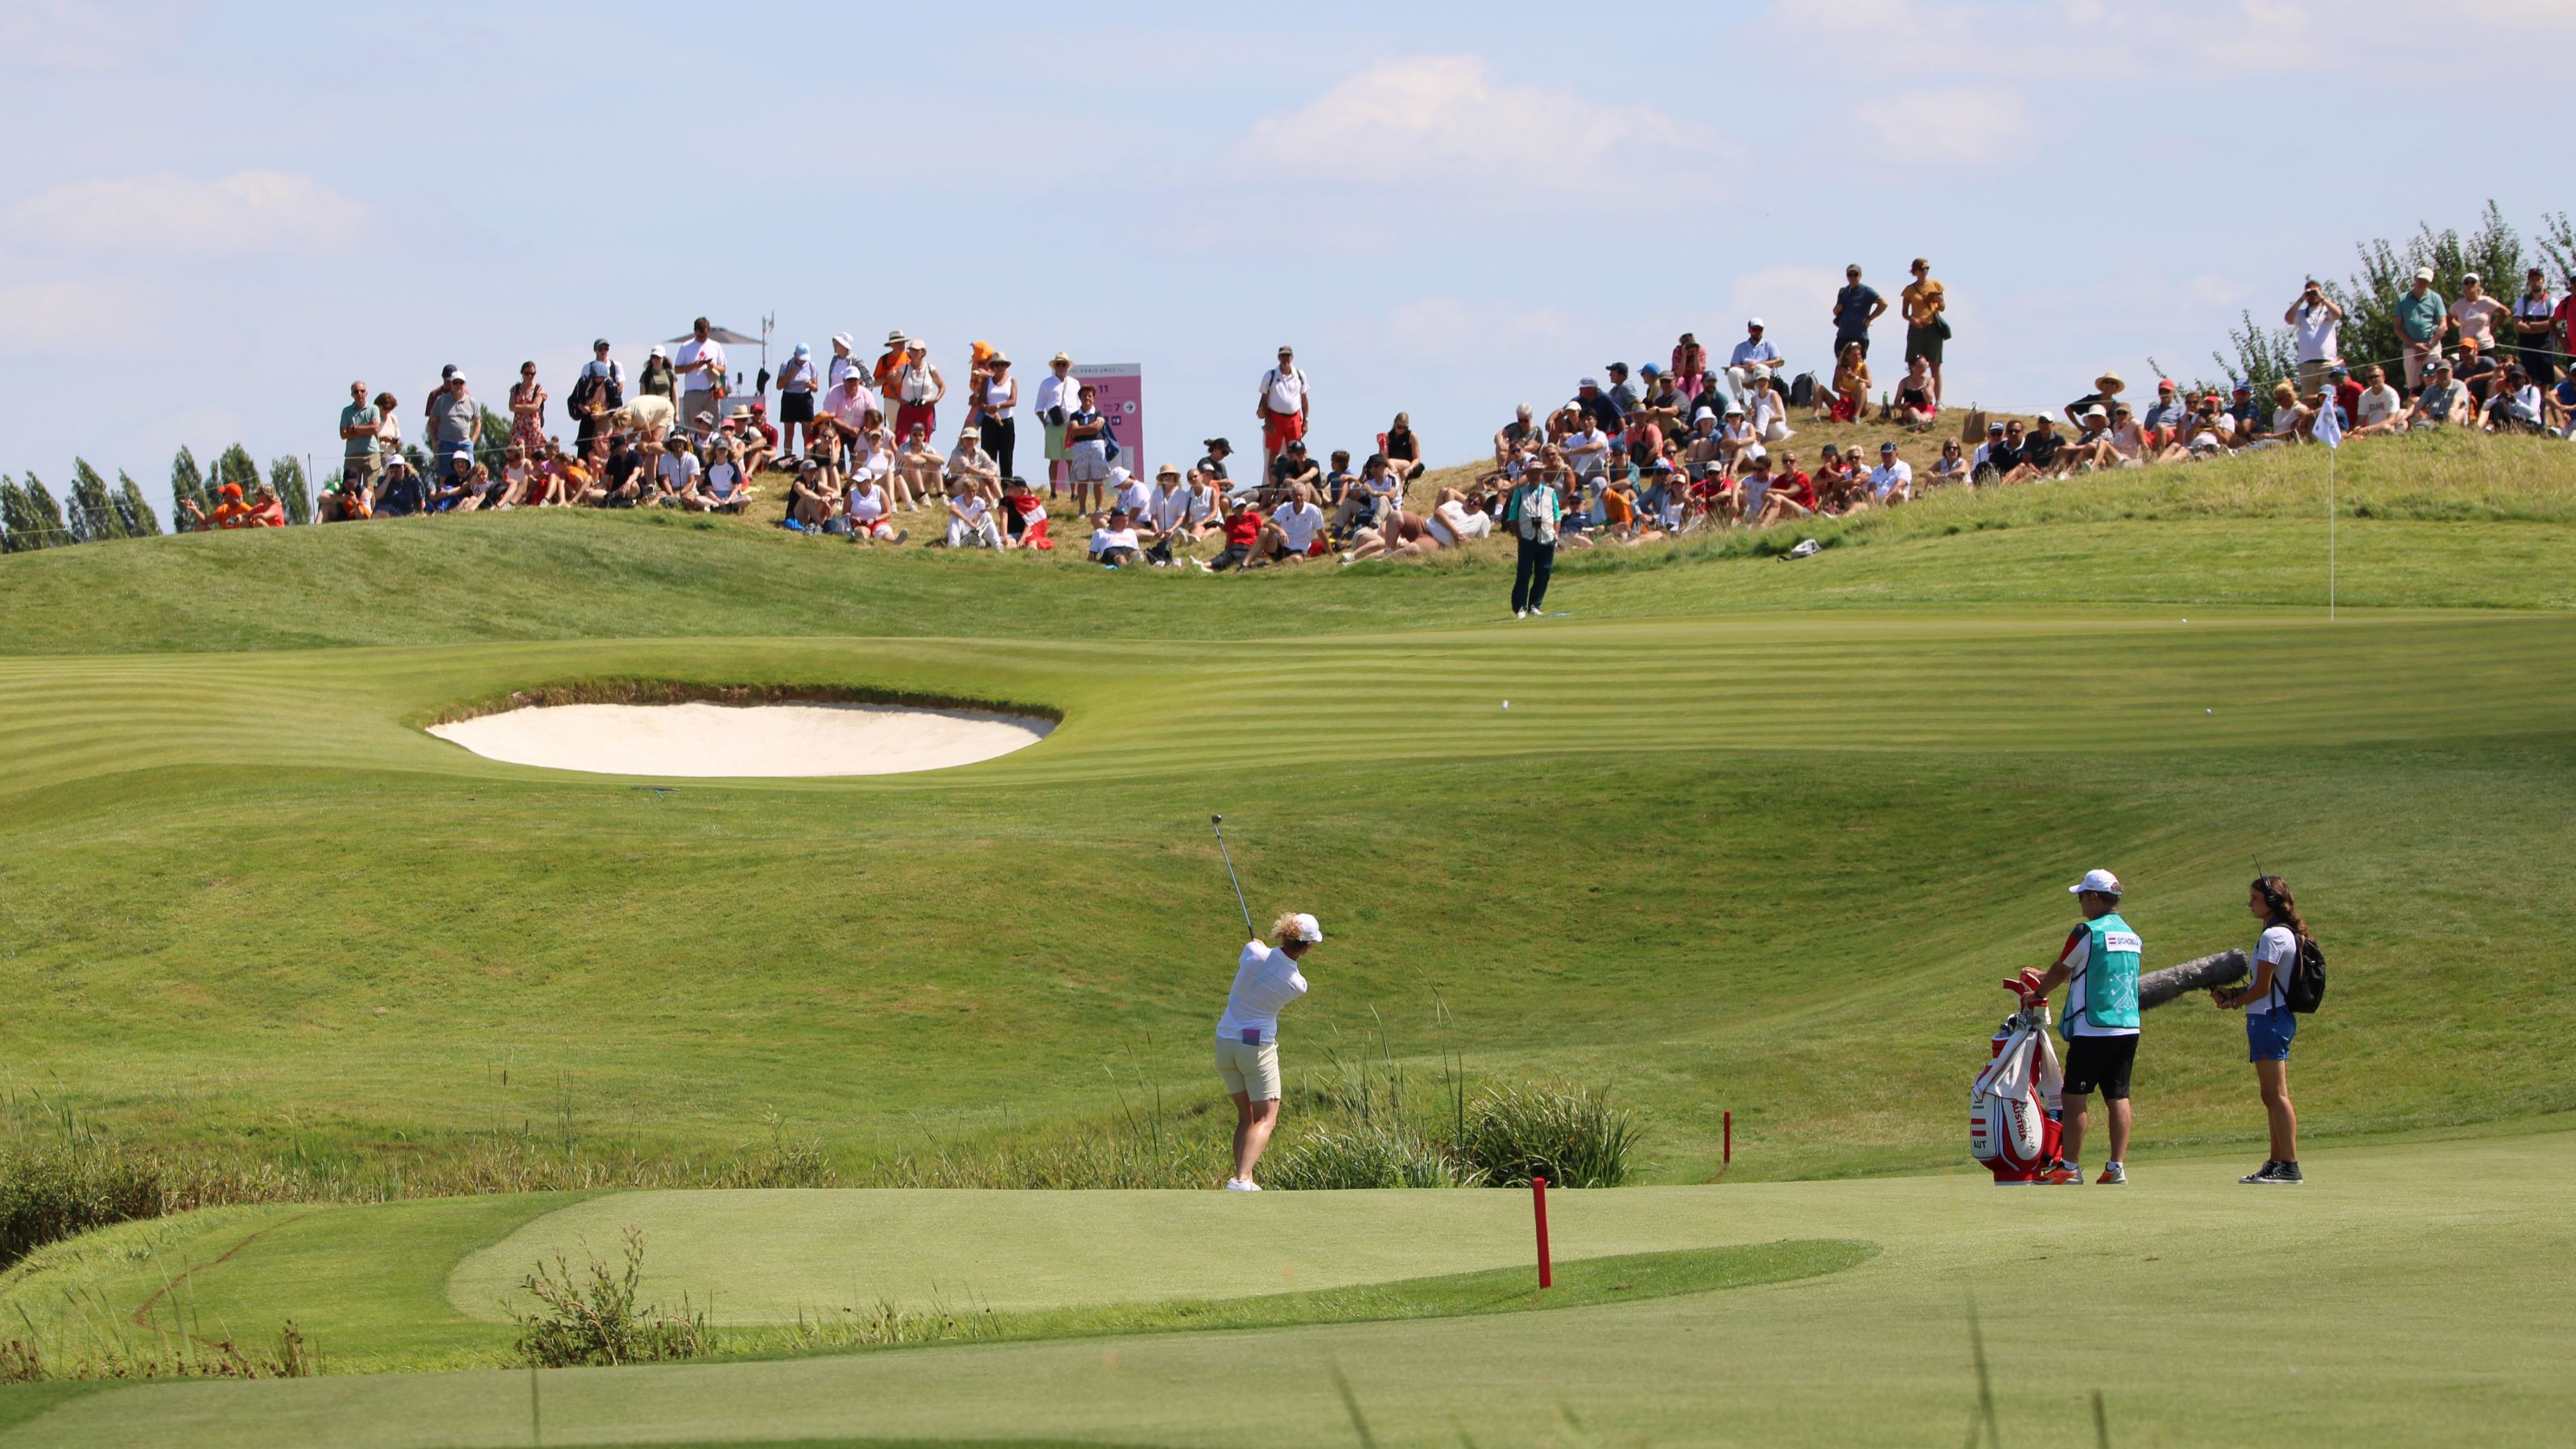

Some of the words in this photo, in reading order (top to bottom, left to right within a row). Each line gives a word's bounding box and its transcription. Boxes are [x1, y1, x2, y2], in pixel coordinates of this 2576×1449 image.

[1099, 385, 1108, 393] 11
[1114, 403, 1121, 411] 7
[2011, 1100, 2027, 1141] AUSTRIA
[1974, 1141, 1986, 1149] AUT
